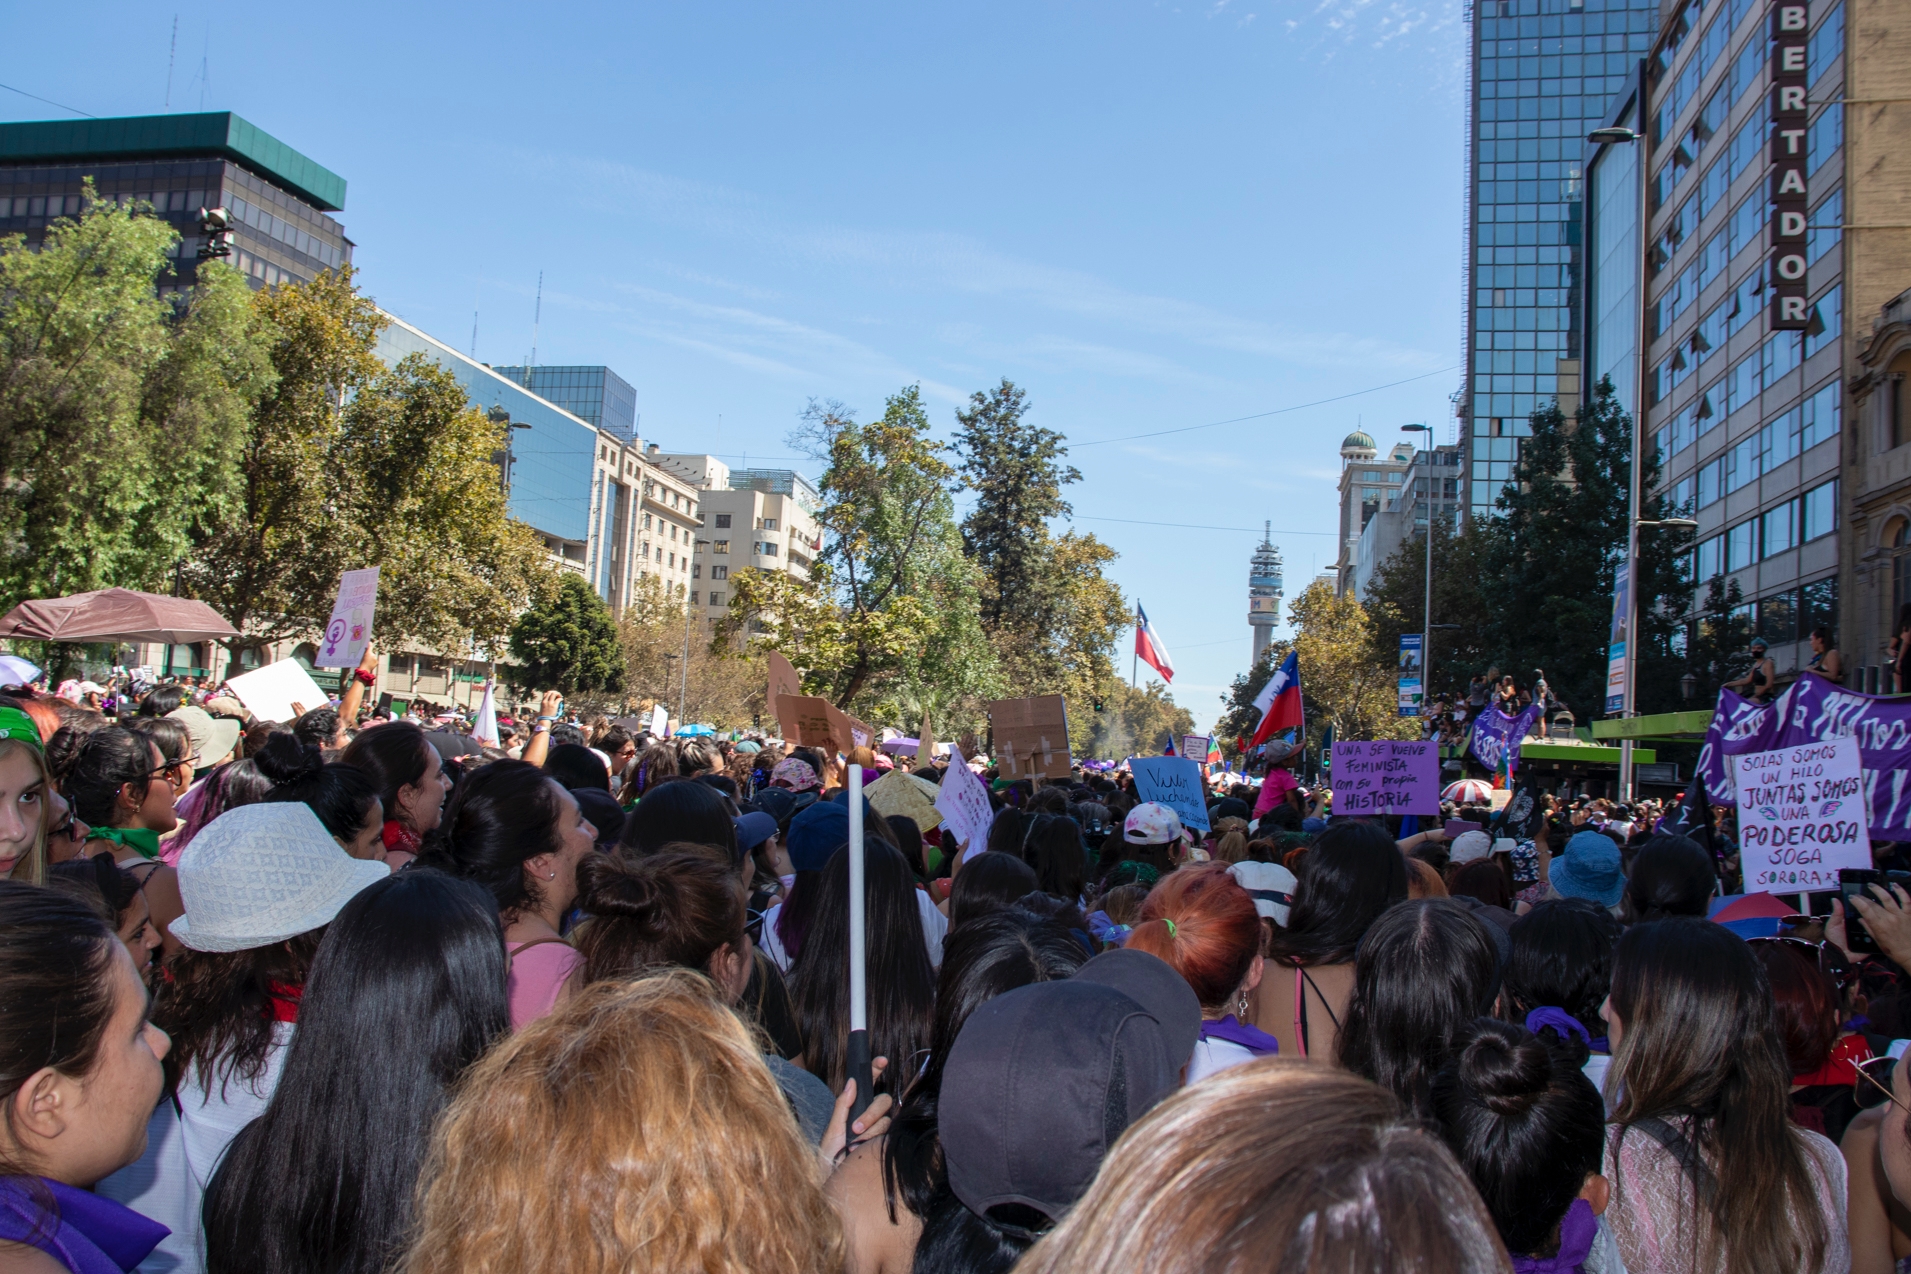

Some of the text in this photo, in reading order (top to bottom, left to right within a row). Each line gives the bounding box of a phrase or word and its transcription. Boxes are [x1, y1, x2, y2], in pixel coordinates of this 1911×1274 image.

[1337, 745, 1362, 756] UNA
[1369, 743, 1386, 757] SE
[1742, 745, 1836, 771] SOLAS SOMOS
[1335, 779, 1353, 791] con
[1381, 773, 1418, 788] propia
[1761, 770, 1780, 784] UN
[1742, 783, 1805, 810] JUNTAS
[1811, 777, 1860, 802] SOMOS
[1781, 805, 1809, 821] UNA
[1741, 820, 1859, 848] PODEROSA
[1768, 848, 1822, 865] SOGA
[1756, 870, 1821, 885] SORORA
